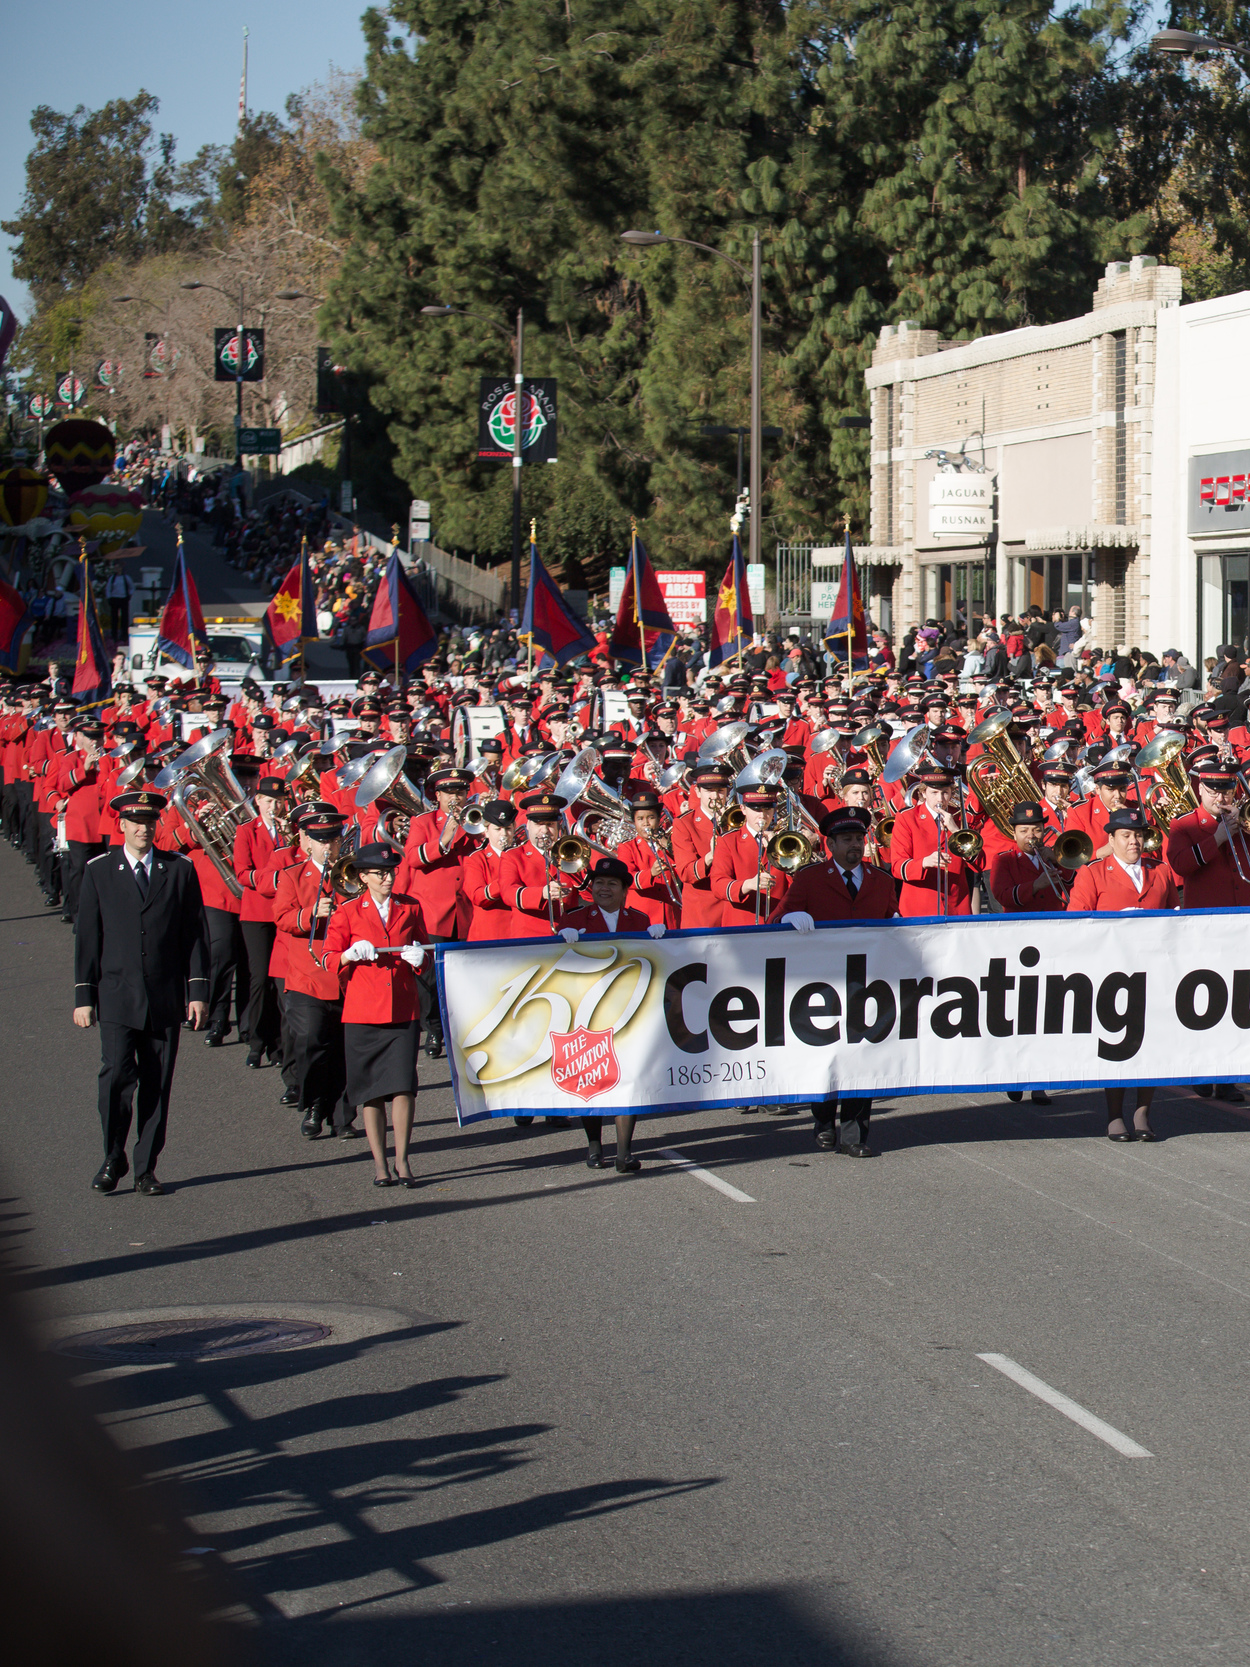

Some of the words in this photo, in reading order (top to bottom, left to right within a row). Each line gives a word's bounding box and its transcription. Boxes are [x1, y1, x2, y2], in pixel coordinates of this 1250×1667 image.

[481, 382, 512, 411] ROSE
[942, 488, 986, 499] JAGUAR
[941, 515, 986, 525] RUSNAK
[665, 583, 696, 597] AREA
[461, 945, 652, 1086] 150
[663, 945, 1147, 1062] Celebrating
[555, 1036, 611, 1084] SALVATION
[561, 1033, 588, 1061] THE
[575, 1058, 611, 1094] ARMY
[666, 1059, 768, 1088] 1865-2015
